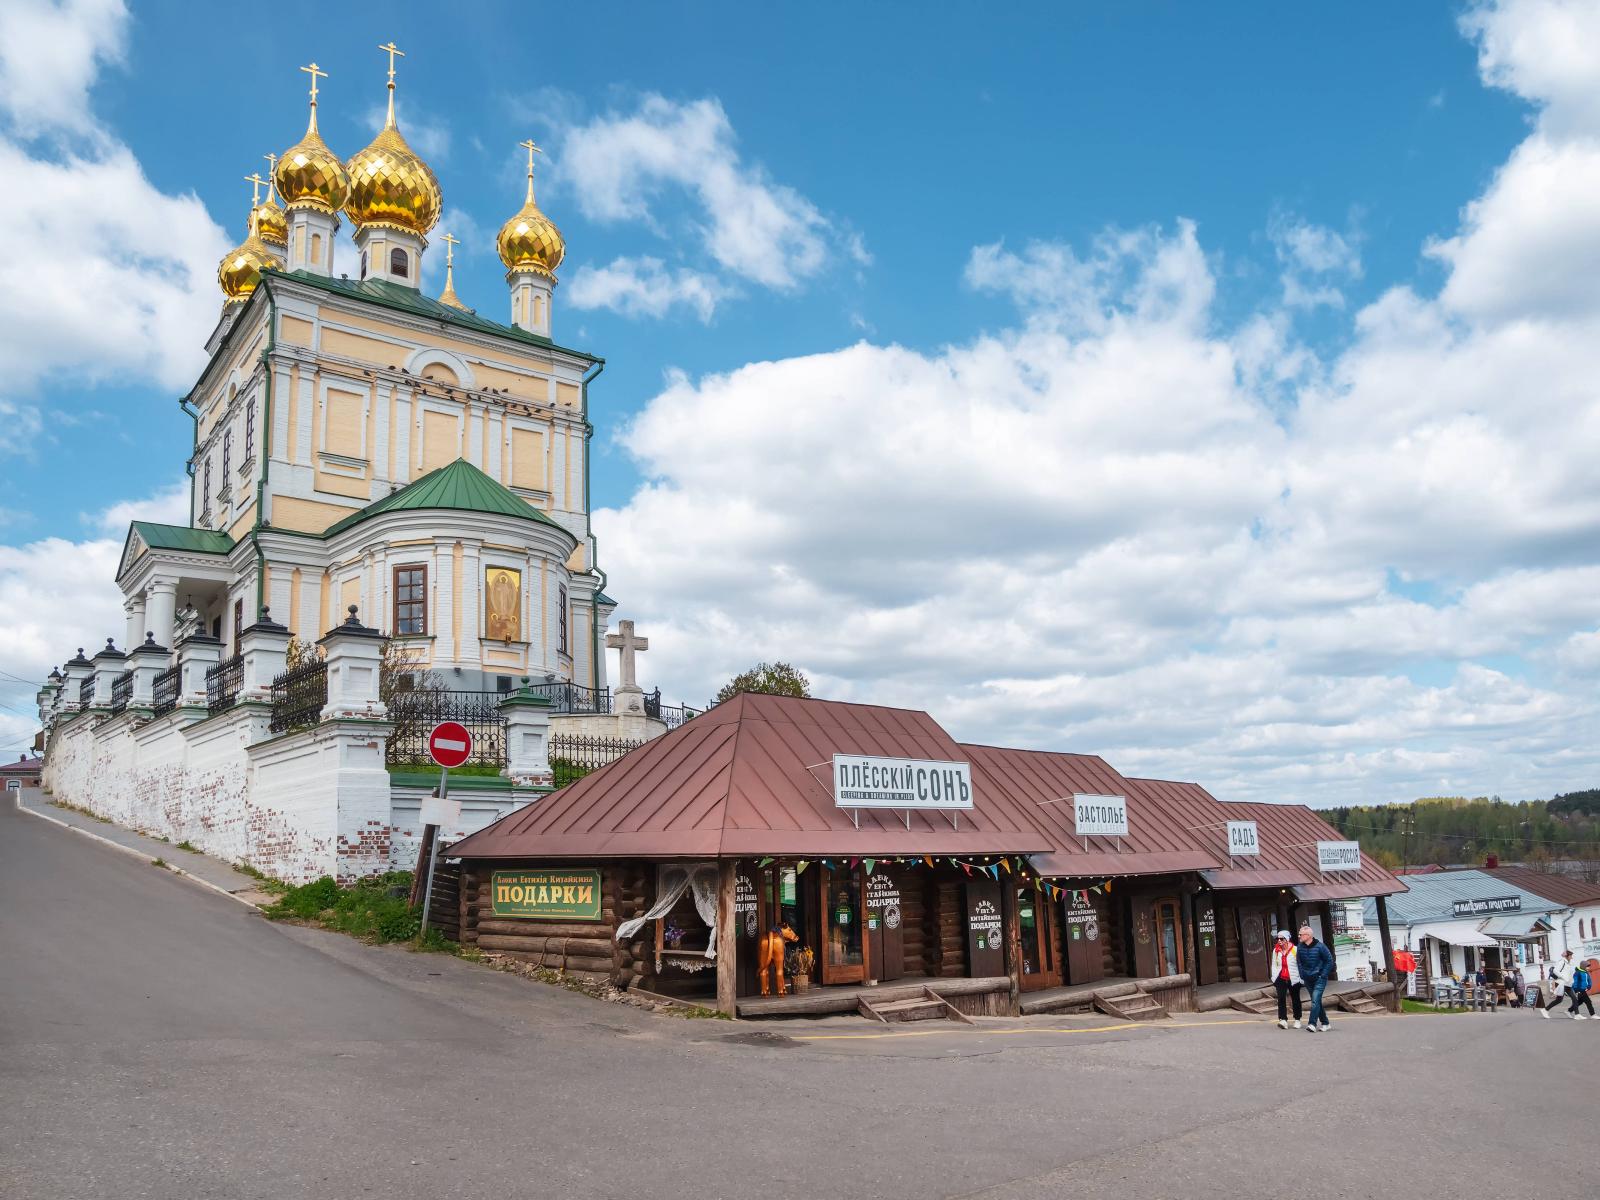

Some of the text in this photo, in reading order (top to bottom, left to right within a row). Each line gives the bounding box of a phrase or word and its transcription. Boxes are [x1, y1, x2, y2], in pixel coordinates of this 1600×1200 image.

[840, 762, 969, 801] ПЛЁССКІЙ СОНЪ
[1078, 805, 1124, 823] ЗАСТОЛЬЕ
[1232, 827, 1254, 847] САДЪ
[497, 886, 593, 906] ПОДАРКИ
[866, 898, 900, 907] ОДАРКИ
[970, 922, 1001, 930] ПОДАРКИ
[1067, 915, 1097, 923] ПОДАРКИ
